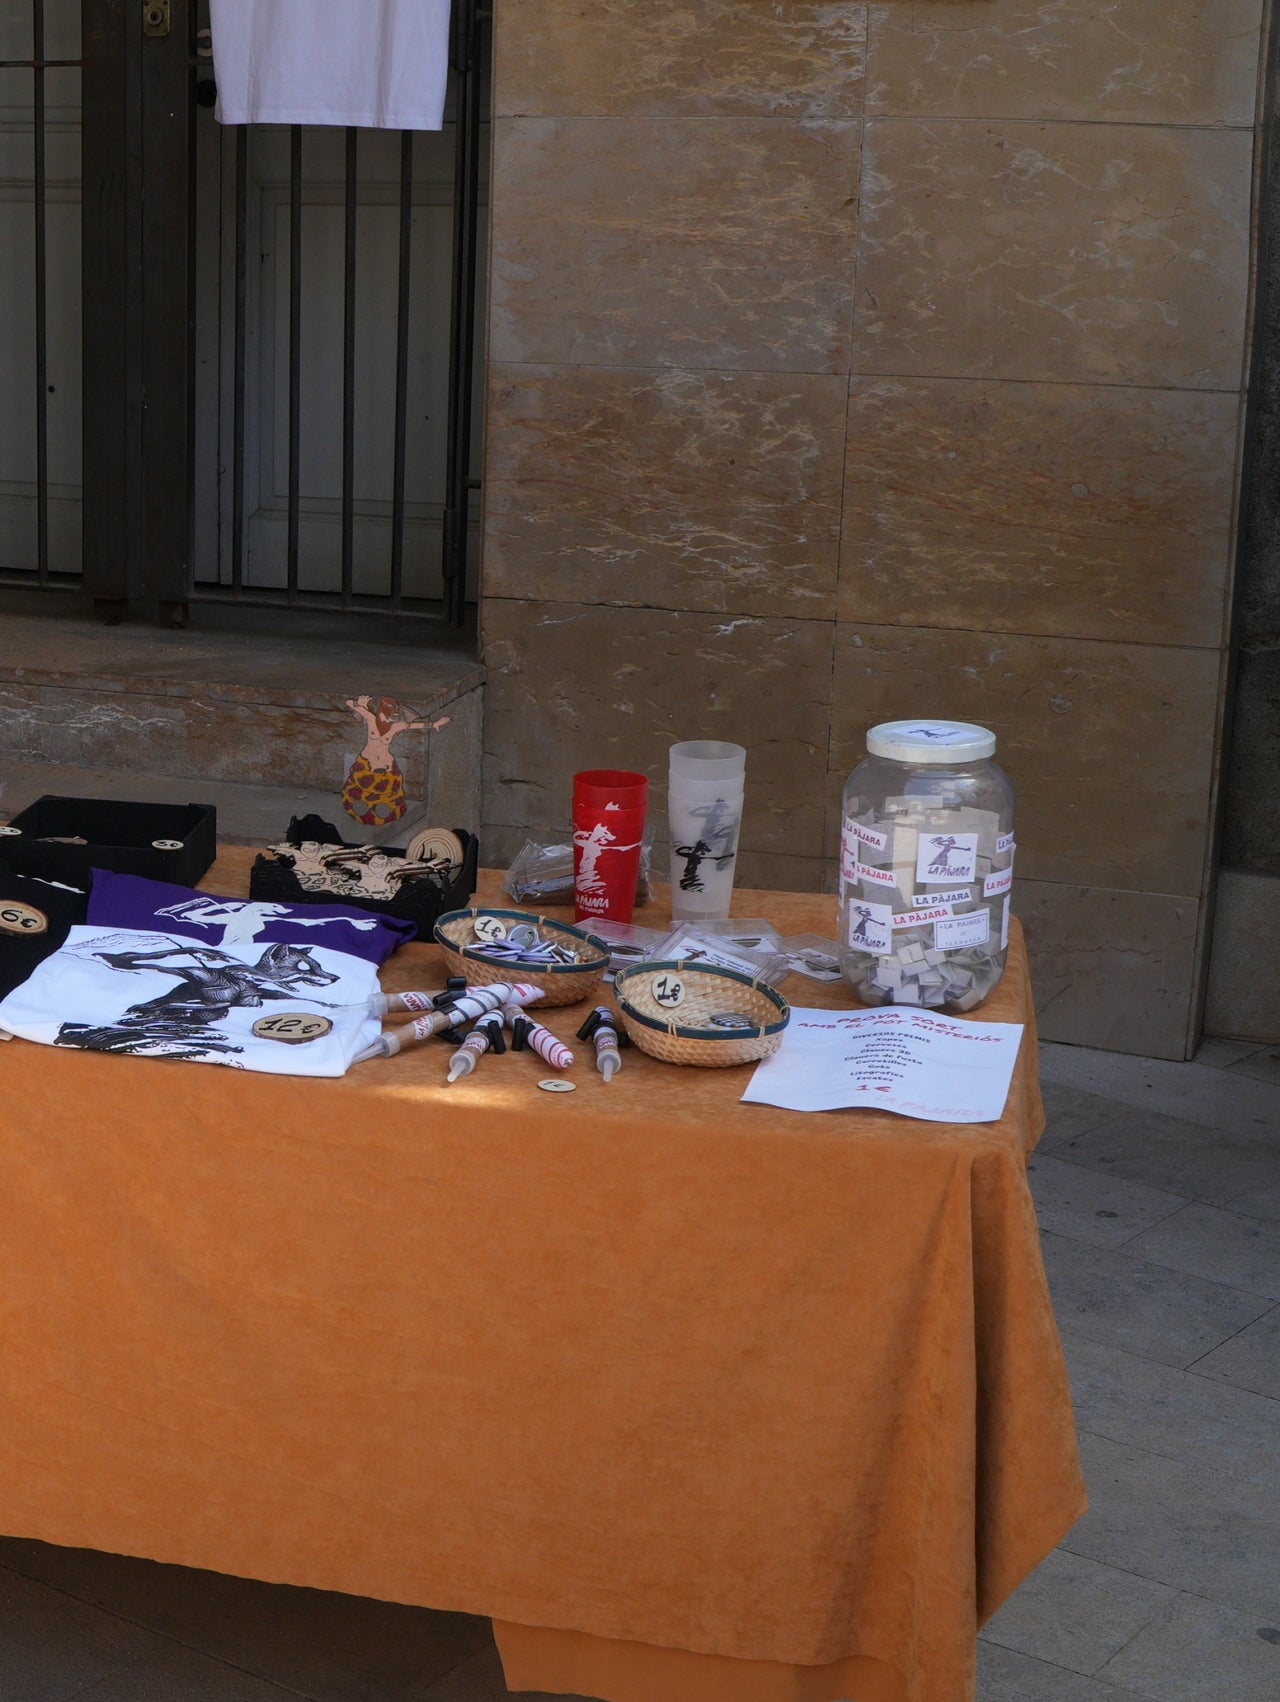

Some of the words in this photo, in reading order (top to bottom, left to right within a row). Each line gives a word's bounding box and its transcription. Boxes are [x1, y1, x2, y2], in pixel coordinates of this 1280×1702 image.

[861, 867, 894, 882] PÀJARA
[916, 897, 929, 905] LA
[931, 891, 970, 904] PÀJARA
[893, 916, 907, 925] LA
[908, 908, 948, 923] PÀJARA
[837, 1013, 901, 1024] PROVA
[911, 1015, 964, 1031] SORT
[897, 1032, 931, 1043] PREMIS
